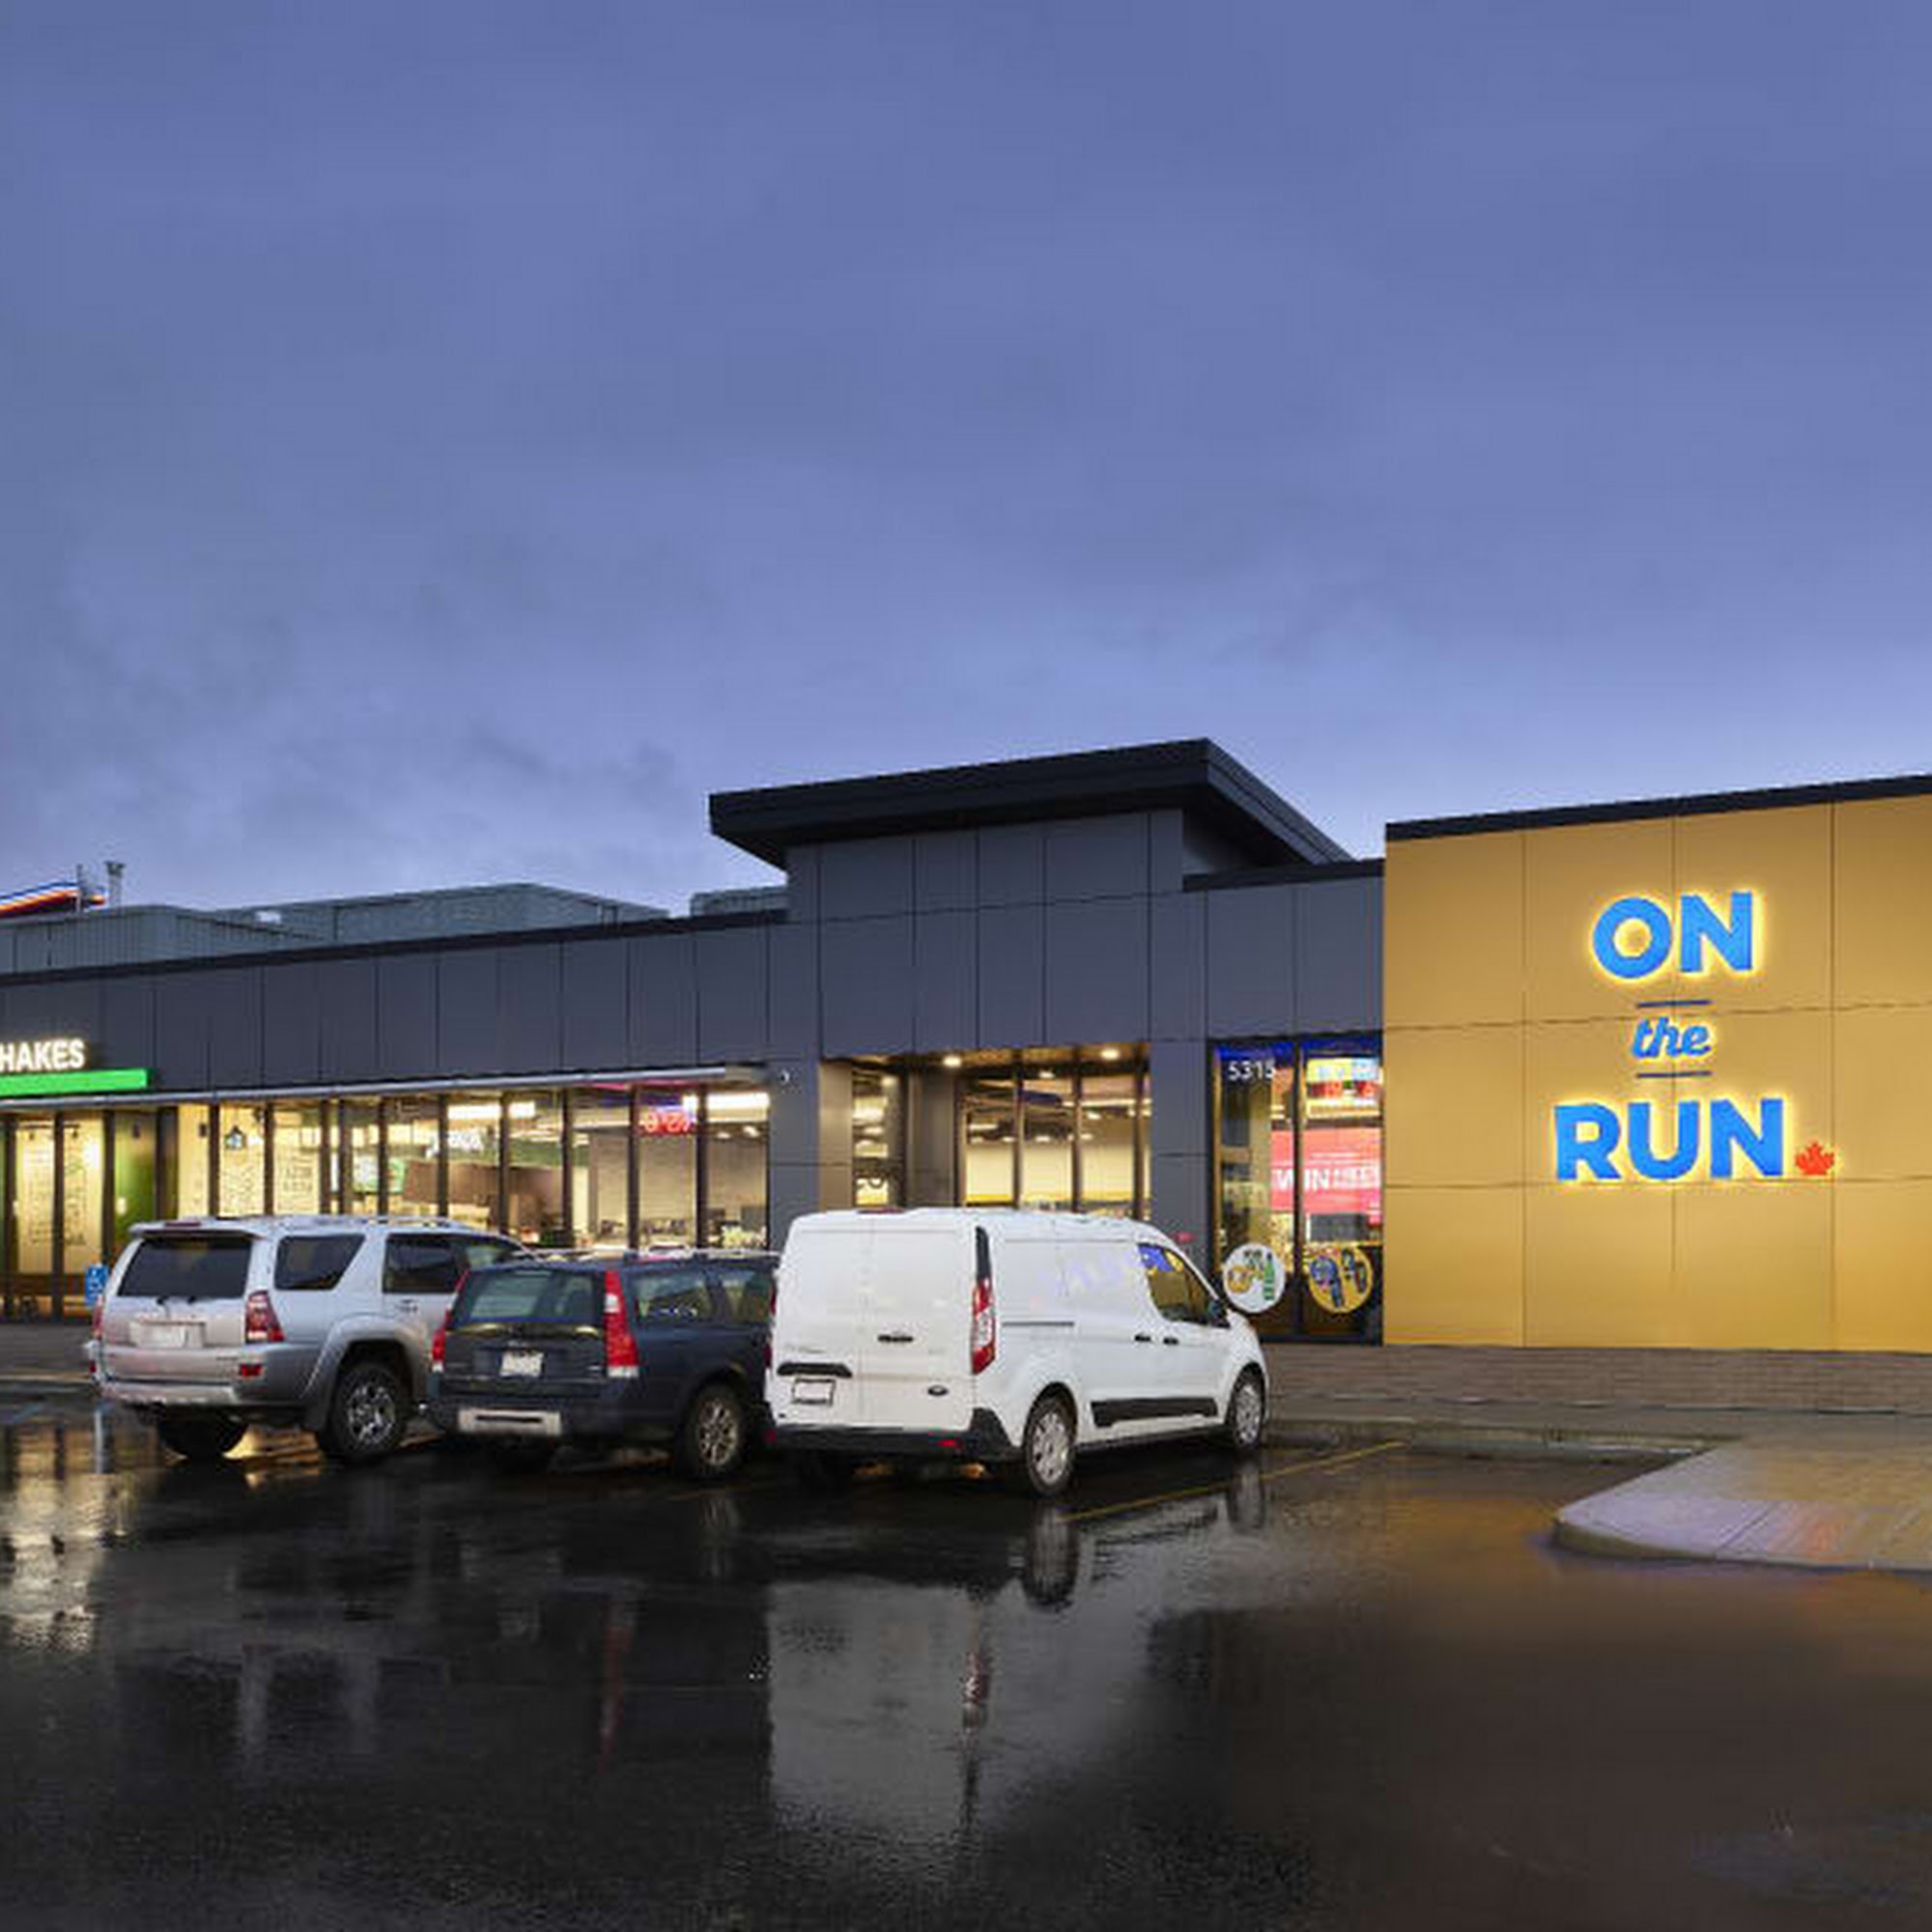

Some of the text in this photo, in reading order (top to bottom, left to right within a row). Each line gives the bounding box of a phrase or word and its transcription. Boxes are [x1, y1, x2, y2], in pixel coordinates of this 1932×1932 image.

[1593, 891, 1752, 979] ON
[0, 1037, 85, 1072] HAKES
[1631, 1016, 1712, 1058] the
[1554, 1097, 1783, 1180] RUN
